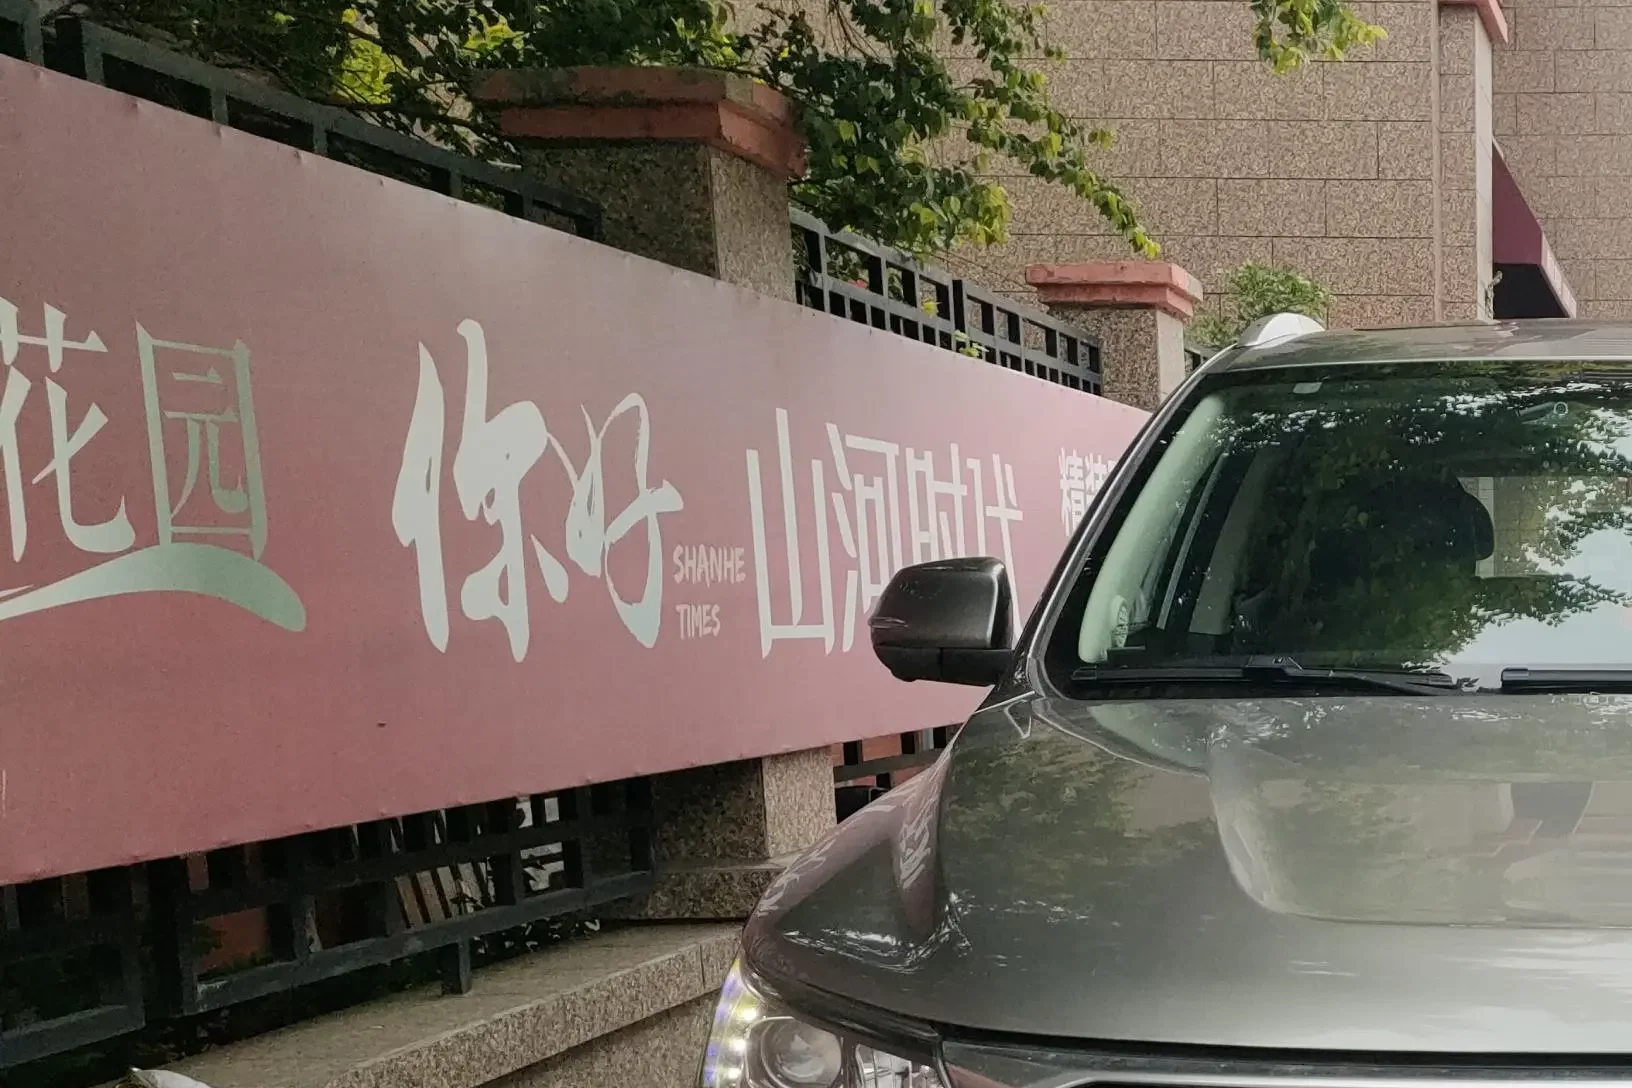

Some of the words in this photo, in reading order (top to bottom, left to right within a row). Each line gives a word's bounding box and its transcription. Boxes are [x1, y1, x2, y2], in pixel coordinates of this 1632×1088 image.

[0, 296, 268, 562] 花园
[392, 318, 684, 664] 你好
[673, 543, 746, 588] SHANHE
[675, 603, 721, 640] TIMES
